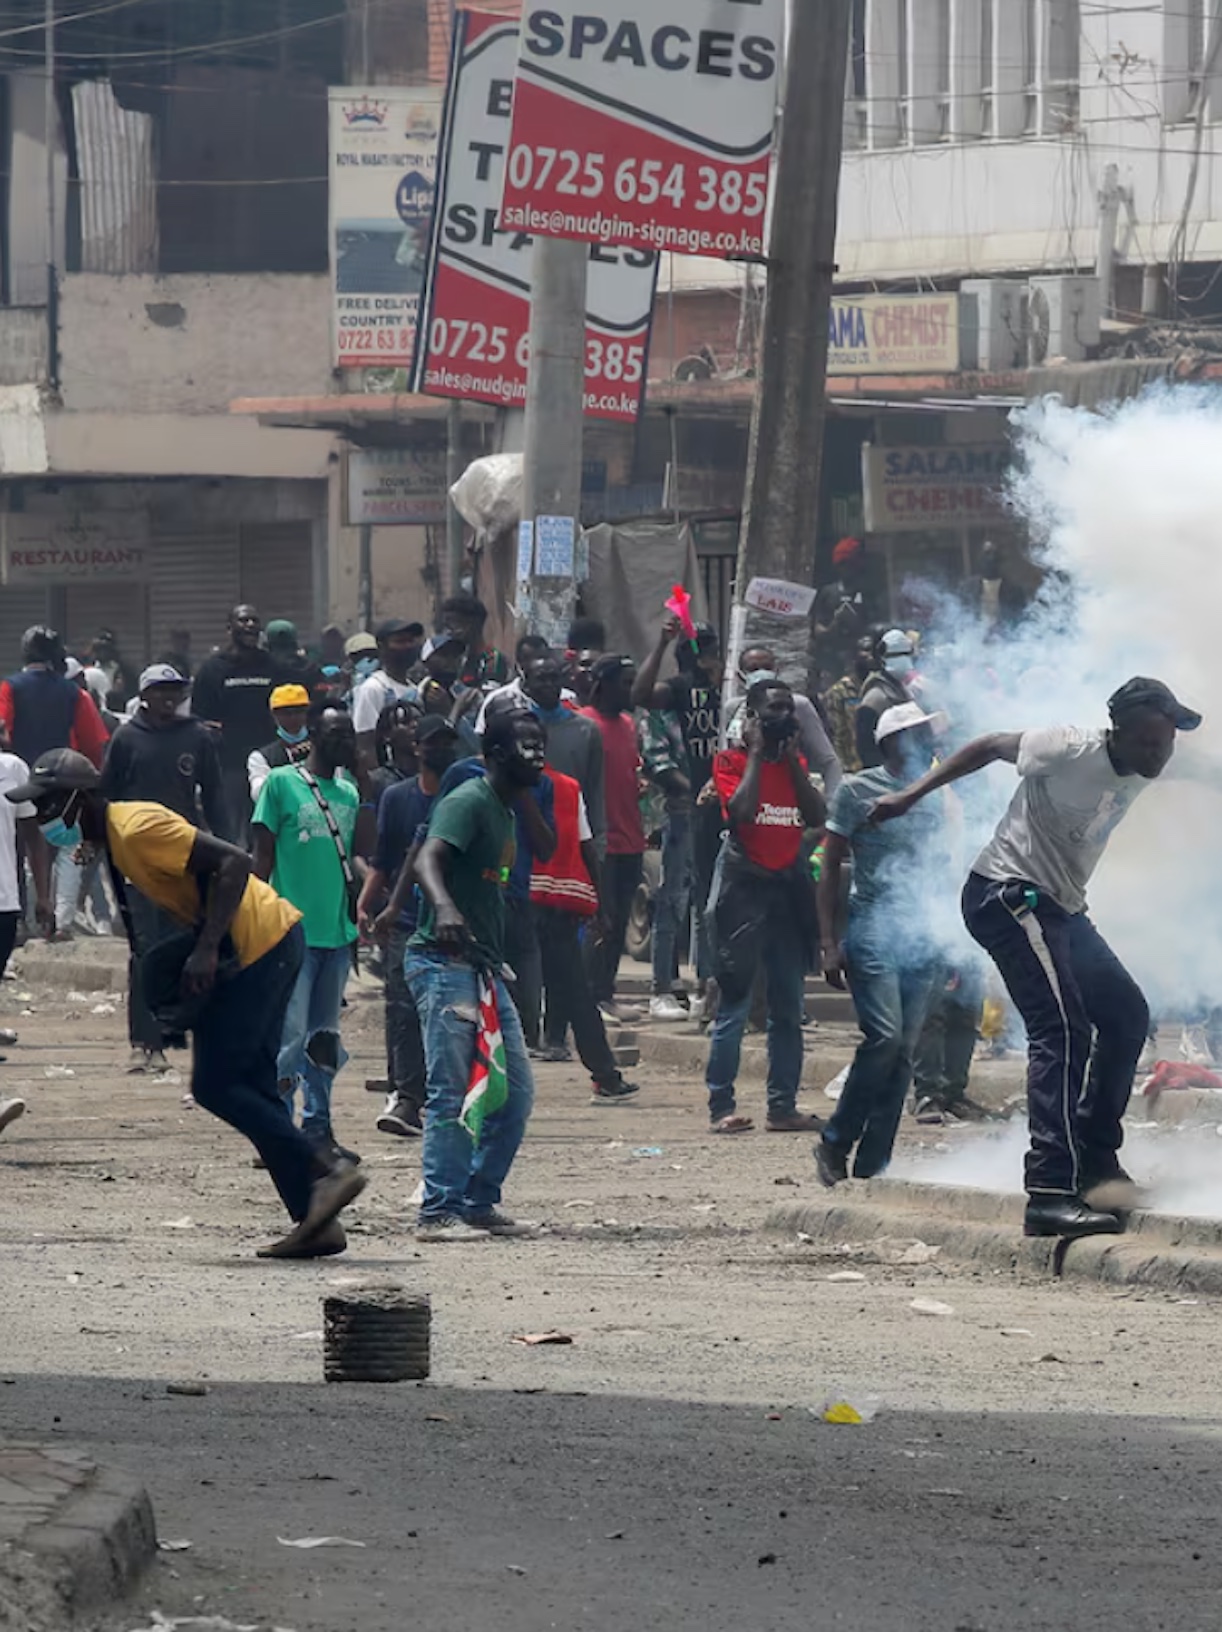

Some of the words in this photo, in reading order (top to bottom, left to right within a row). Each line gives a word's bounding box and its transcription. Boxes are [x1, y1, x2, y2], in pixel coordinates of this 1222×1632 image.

[525, 10, 776, 81] SPACES
[509, 144, 604, 198] 0725
[614, 158, 685, 208] 654
[695, 166, 767, 216] 385
[504, 203, 761, 252] sales@nudgim-signage.co.ke
[338, 297, 373, 309] FREE
[340, 315, 402, 327] COUNTRY
[873, 303, 950, 347] CHEMIST
[338, 329, 372, 350] 0722
[377, 329, 395, 350] 63
[429, 317, 508, 363] 0725
[584, 339, 645, 382] 385
[11, 550, 143, 566] RESTAURANT
